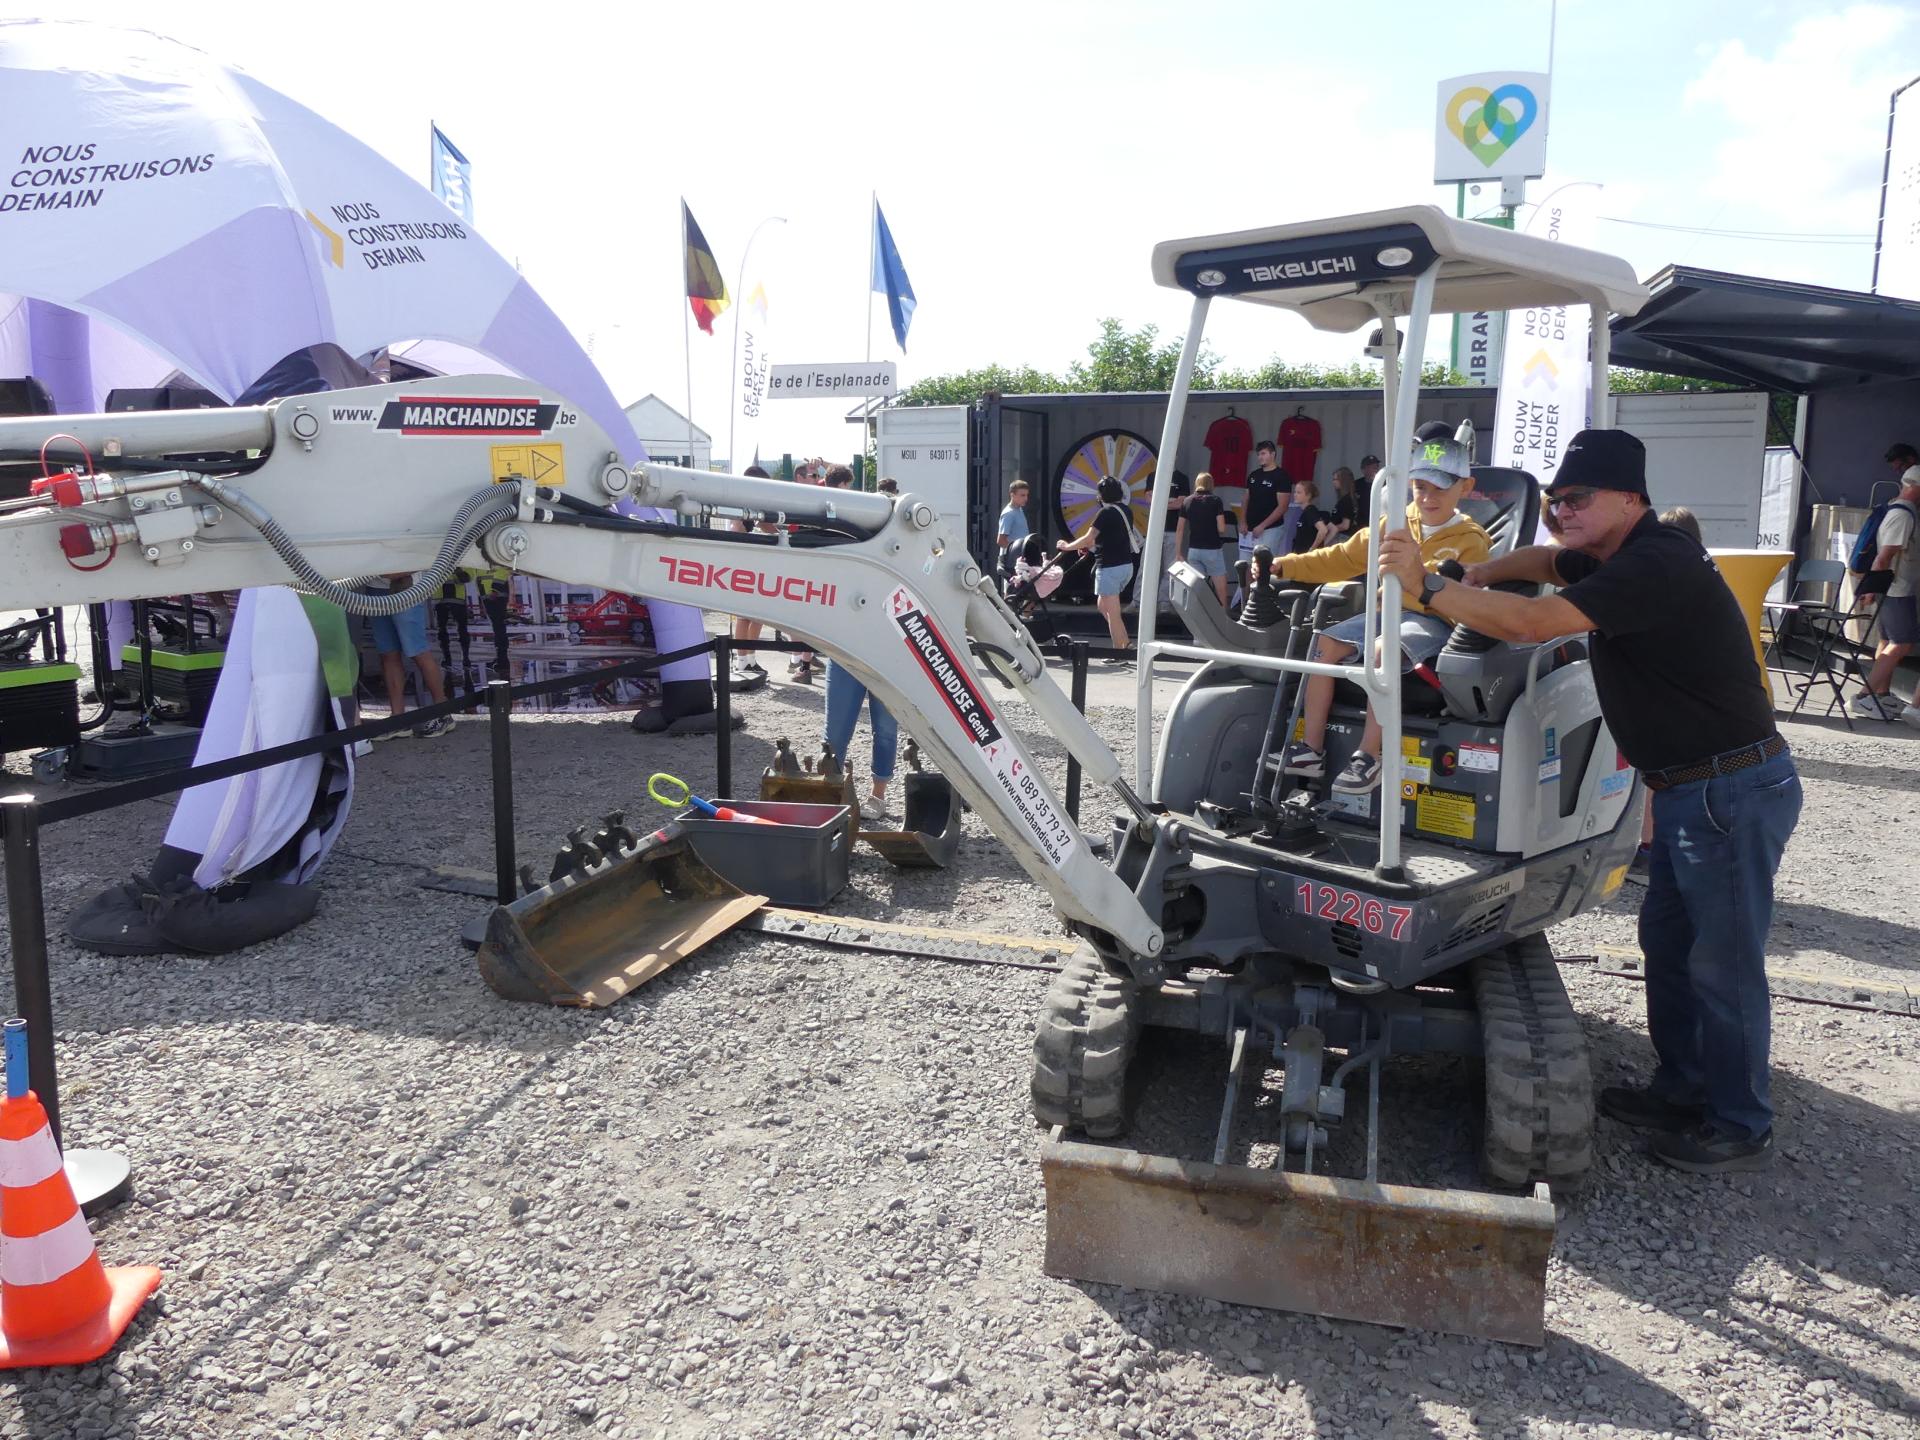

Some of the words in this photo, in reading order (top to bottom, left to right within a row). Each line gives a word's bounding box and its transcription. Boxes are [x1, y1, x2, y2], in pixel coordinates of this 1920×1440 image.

[11, 153, 216, 188] CONSTRUISONS
[21, 143, 97, 165] NOUS
[0, 188, 104, 212] DEMAIN
[331, 202, 381, 224] NOUS
[347, 222, 467, 246] CONSTRUISONS
[1548, 207, 1562, 241] ONS
[362, 245, 426, 270] DEMAIN
[743, 330, 754, 388] BOUW
[769, 375, 782, 388] te
[786, 375, 803, 388] de
[807, 371, 890, 391] l'Esplanade
[332, 408, 378, 422] www.
[403, 406, 537, 427] MARCHANDISE
[1513, 400, 1529, 455] BOUW
[1528, 402, 1544, 450] KIJKT
[1543, 404, 1560, 470] VERDER
[904, 615, 975, 714] MARCHANDISE
[967, 712, 990, 743] Genk
[997, 769, 1061, 864] www.marchandise.be
[1020, 775, 1039, 800] 089
[1035, 798, 1050, 817] 35
[1046, 813, 1060, 832] 79
[1056, 829, 1071, 847] 37
[1297, 882, 1412, 941] 12267
